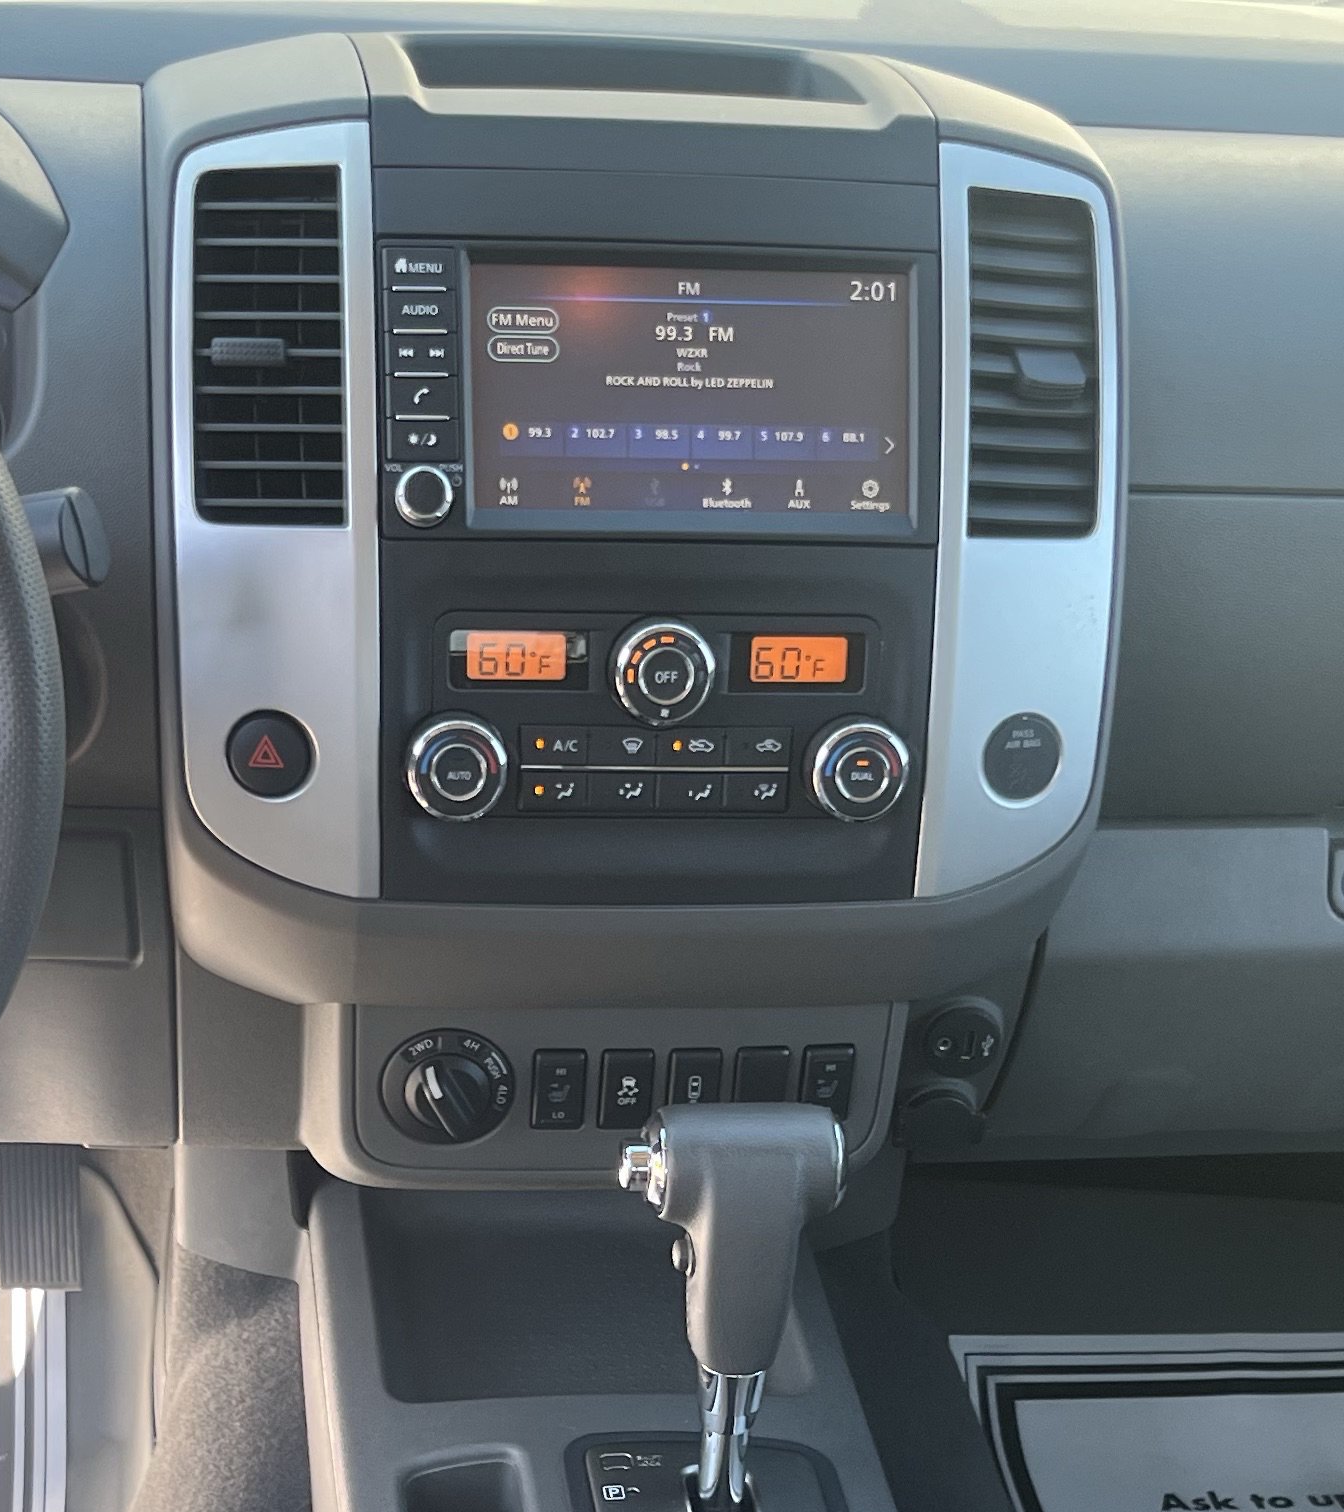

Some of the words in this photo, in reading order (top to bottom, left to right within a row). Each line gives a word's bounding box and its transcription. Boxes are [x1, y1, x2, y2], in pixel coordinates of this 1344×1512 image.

[408, 263, 443, 274] MENU
[677, 281, 701, 296] FM
[849, 280, 897, 302] 2:01
[401, 304, 439, 316] AUDIO
[491, 313, 512, 327] FM
[515, 313, 554, 327] Menu
[666, 312, 698, 323] Preset
[655, 326, 693, 342] 99.3
[709, 327, 734, 342] FM
[496, 342, 524, 356] Direct
[525, 342, 549, 356] Tune
[677, 362, 702, 372] Rock
[606, 375, 635, 386] ROCK
[637, 376, 661, 387] AND
[663, 377, 688, 388] ROLL
[691, 376, 703, 389] by
[705, 377, 725, 388] LED
[727, 378, 774, 389] ZEPPELIN
[528, 427, 552, 438] 99.3
[571, 428, 579, 438] 2
[586, 428, 615, 439] 102.7
[635, 429, 642, 439] 3
[697, 430, 705, 440] 4
[384, 463, 403, 472] VOL
[499, 495, 519, 506] AM
[574, 496, 591, 506] FM
[702, 498, 752, 509] Bluetooth
[787, 499, 811, 510] AUX
[850, 500, 890, 513] Settings
[655, 671, 679, 685] OFF
[553, 740, 578, 752] A/C
[447, 771, 472, 780] AUTO
[408, 1039, 434, 1056] 2WD
[463, 1039, 480, 1051] 4H
[617, 1097, 637, 1106] OFF
[1161, 1491, 1239, 1512] Ask
[1251, 1494, 1294, 1510] to
